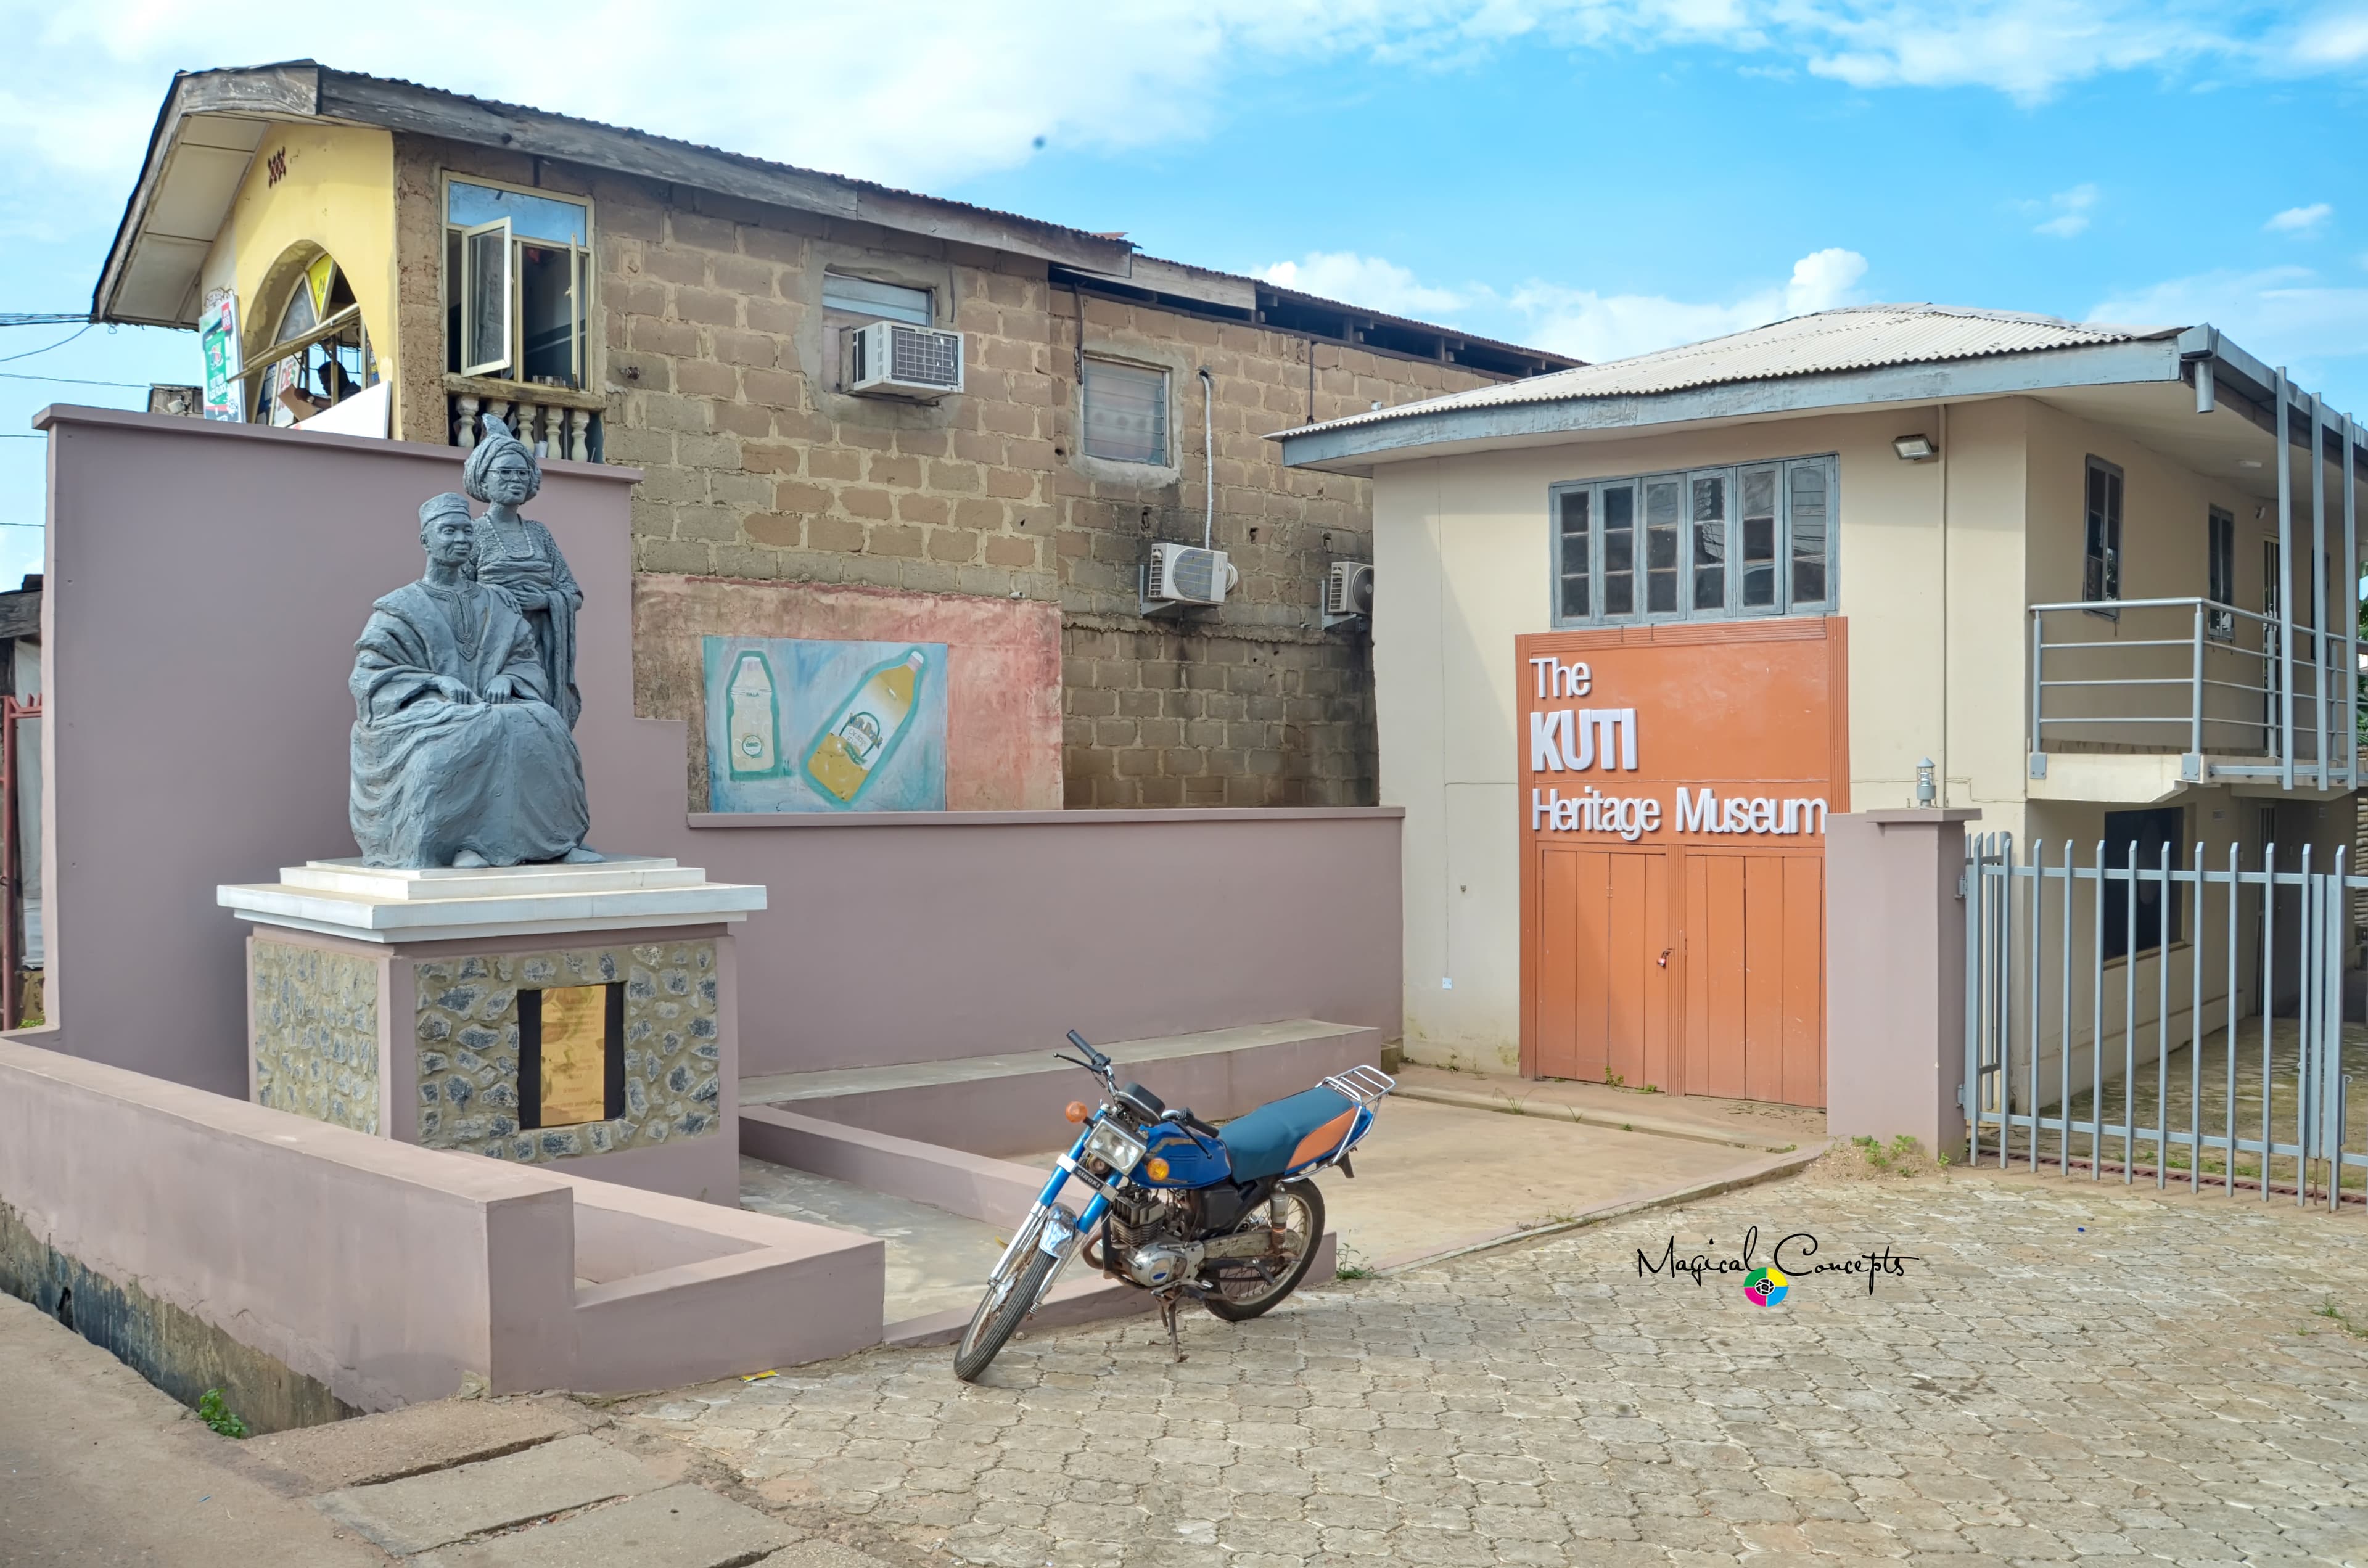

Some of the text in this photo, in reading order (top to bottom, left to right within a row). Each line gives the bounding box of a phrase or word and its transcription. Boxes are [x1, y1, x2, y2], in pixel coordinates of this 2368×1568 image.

[1529, 657, 1592, 698] The
[1531, 708, 1638, 771] KUTI
[1532, 786, 1827, 840] Heritage Museum
[1077, 1170, 1101, 1188] SINOKI
